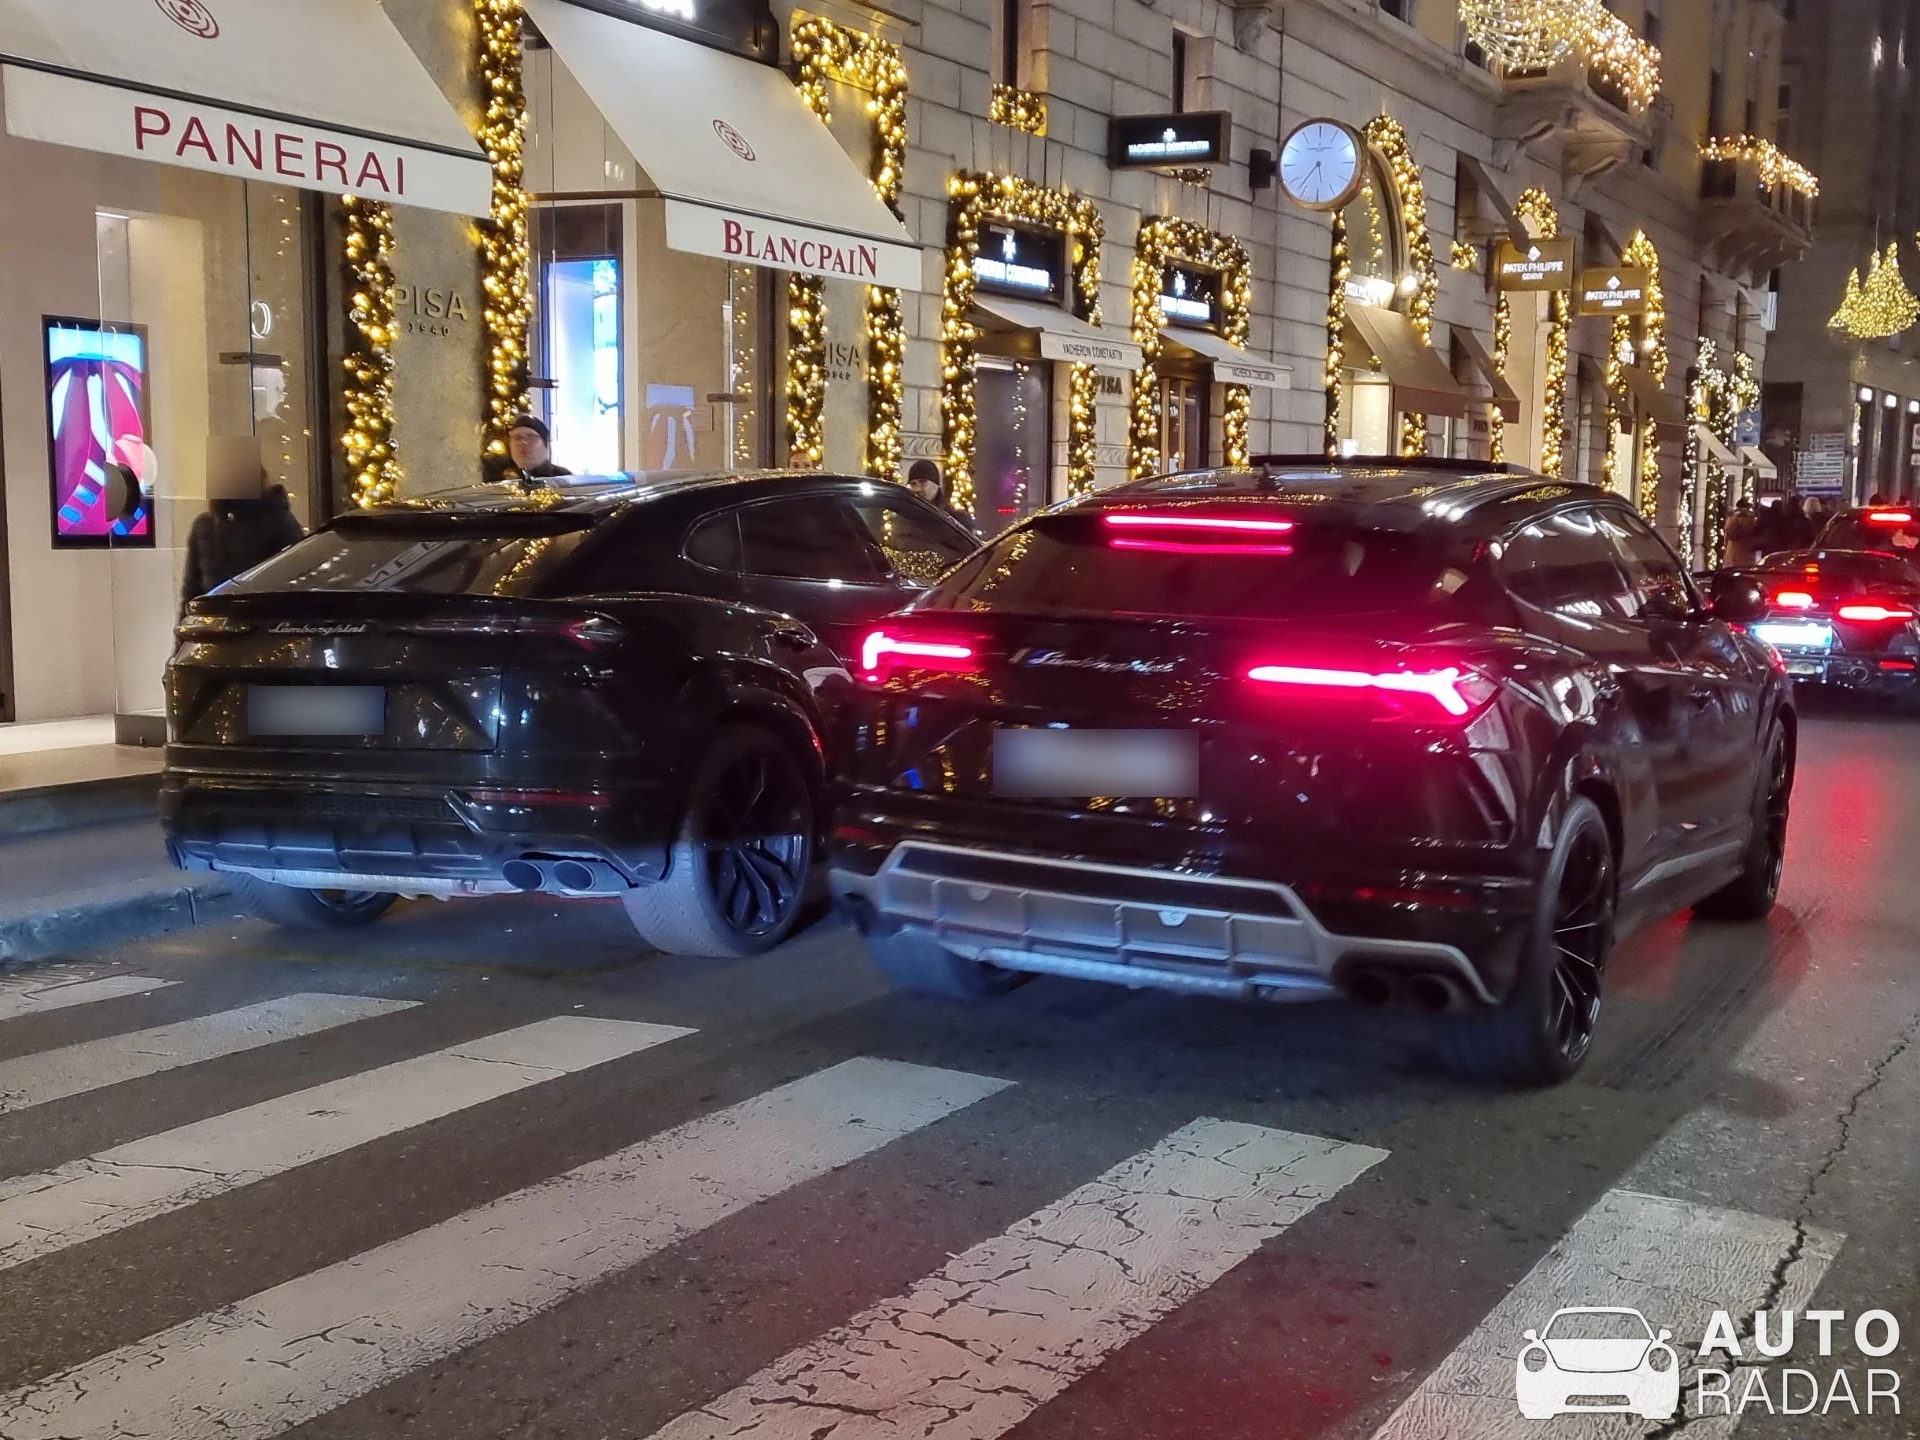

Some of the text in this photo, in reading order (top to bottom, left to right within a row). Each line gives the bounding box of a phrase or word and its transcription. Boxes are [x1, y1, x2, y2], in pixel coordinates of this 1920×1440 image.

[134, 105, 404, 196] PANERAI
[722, 218, 879, 279] BLANCPAIN
[1503, 261, 1564, 273] PATEK PHILIPPE
[392, 284, 468, 321] PISA
[823, 342, 862, 368] ISA
[269, 622, 367, 636] Lamborghini
